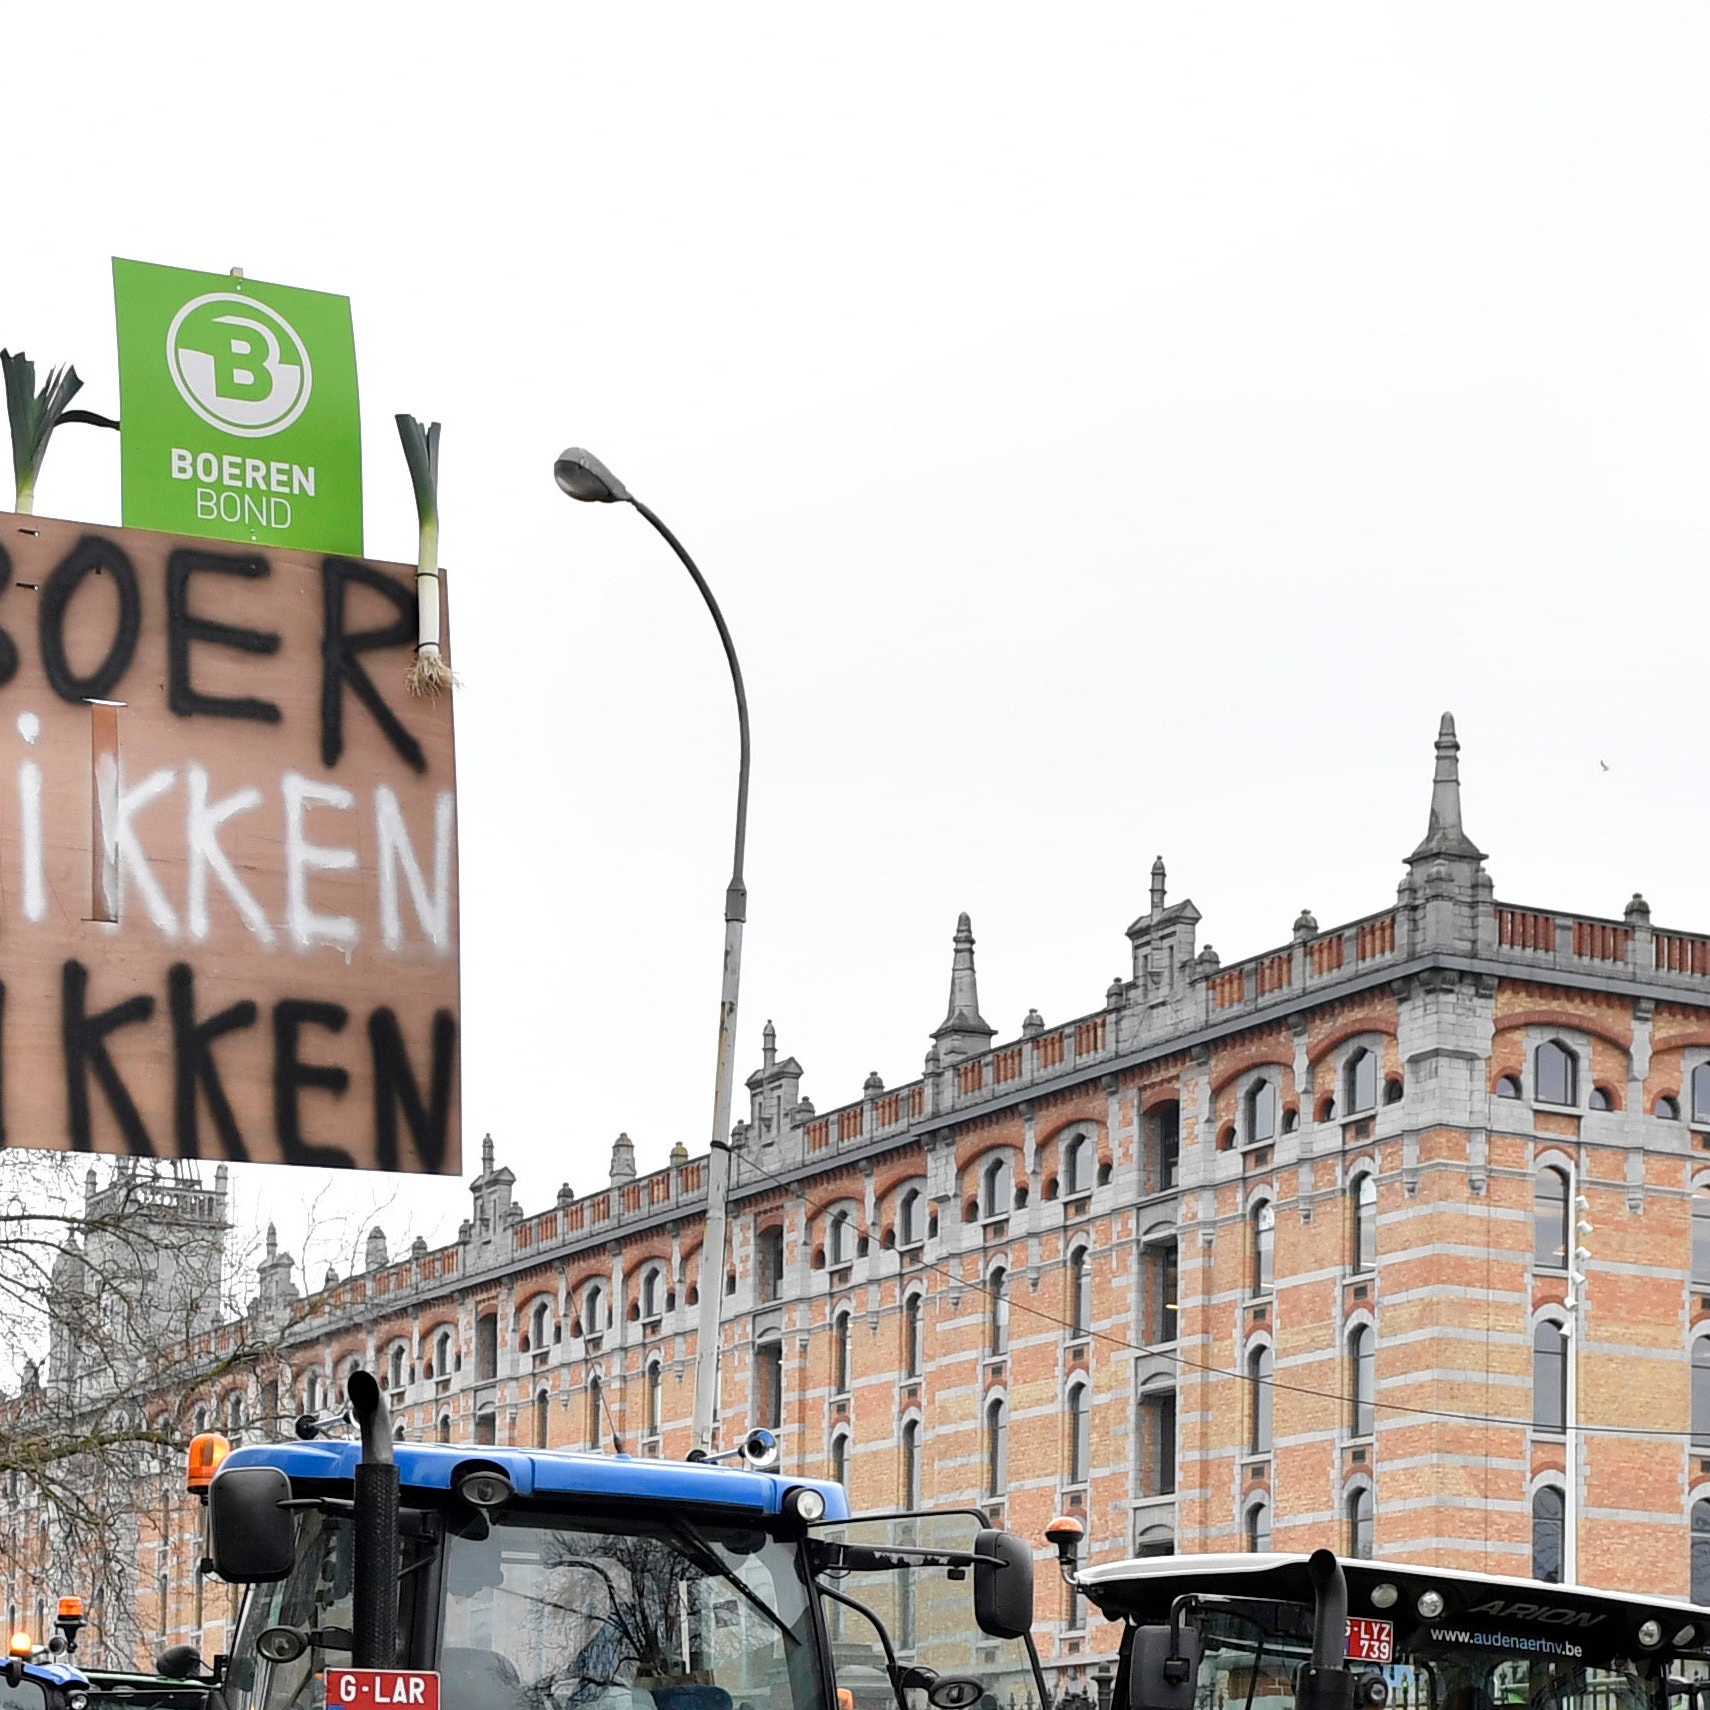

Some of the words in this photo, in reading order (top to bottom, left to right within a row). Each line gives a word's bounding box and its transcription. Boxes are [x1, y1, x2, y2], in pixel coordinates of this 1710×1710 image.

[171, 447, 316, 497] BOEREN
[196, 487, 292, 529] BOND
[1468, 1600, 1608, 1628] ARION
[1359, 1639, 1390, 1660] 739
[1430, 1627, 1583, 1658] www.audenaertnv.be
[339, 1674, 425, 1704] G-LAR
